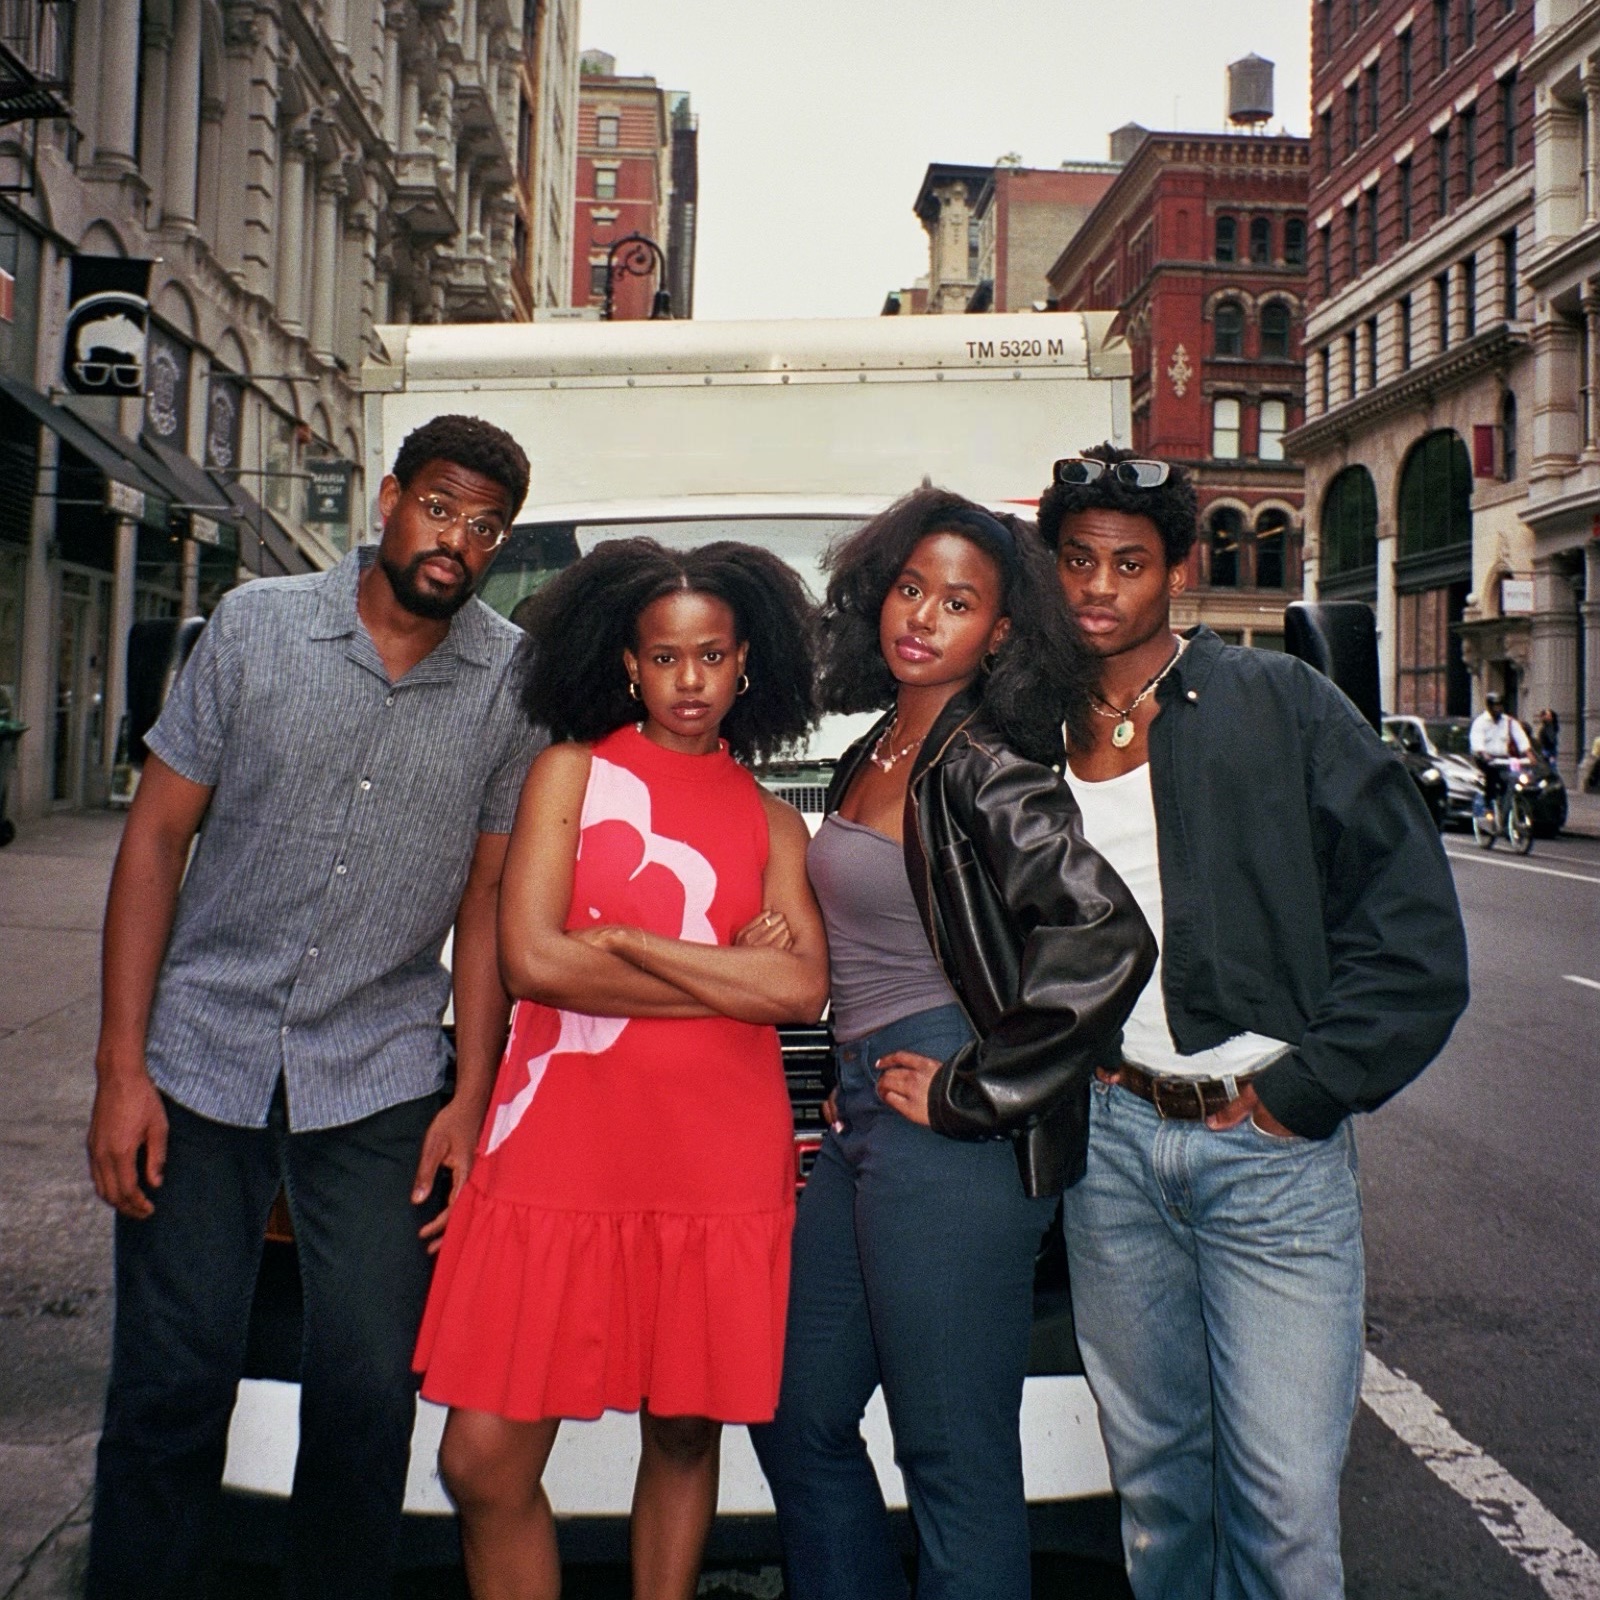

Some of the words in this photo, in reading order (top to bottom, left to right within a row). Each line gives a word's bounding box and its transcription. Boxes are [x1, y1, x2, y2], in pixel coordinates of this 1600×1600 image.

[966, 341, 994, 359] TM
[1000, 339, 1042, 358] 5320
[1047, 339, 1064, 356] M
[313, 473, 346, 483] MARIA
